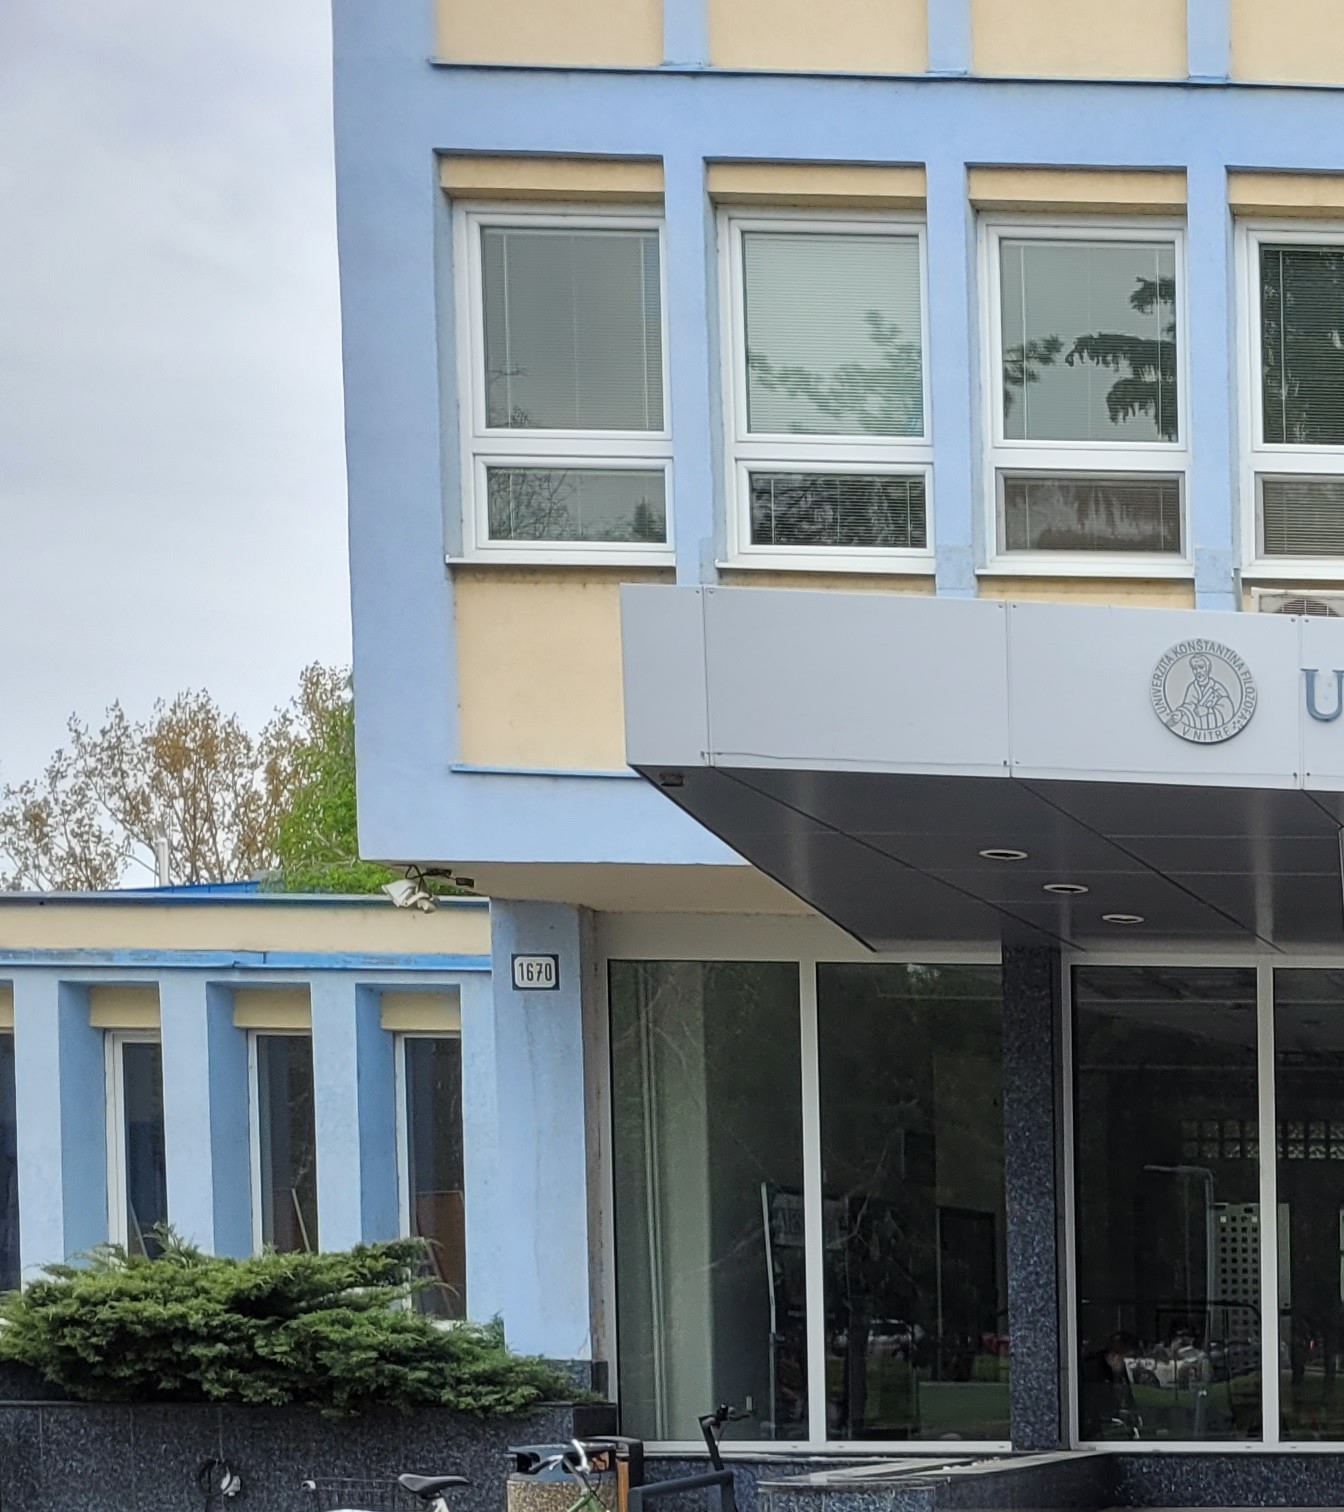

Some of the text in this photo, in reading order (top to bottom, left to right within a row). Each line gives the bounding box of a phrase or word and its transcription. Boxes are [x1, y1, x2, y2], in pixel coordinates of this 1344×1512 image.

[1151, 653, 1174, 714] UNIVERZITA
[1240, 670, 1256, 721] FILOZOFA
[518, 962, 553, 982] 1670
